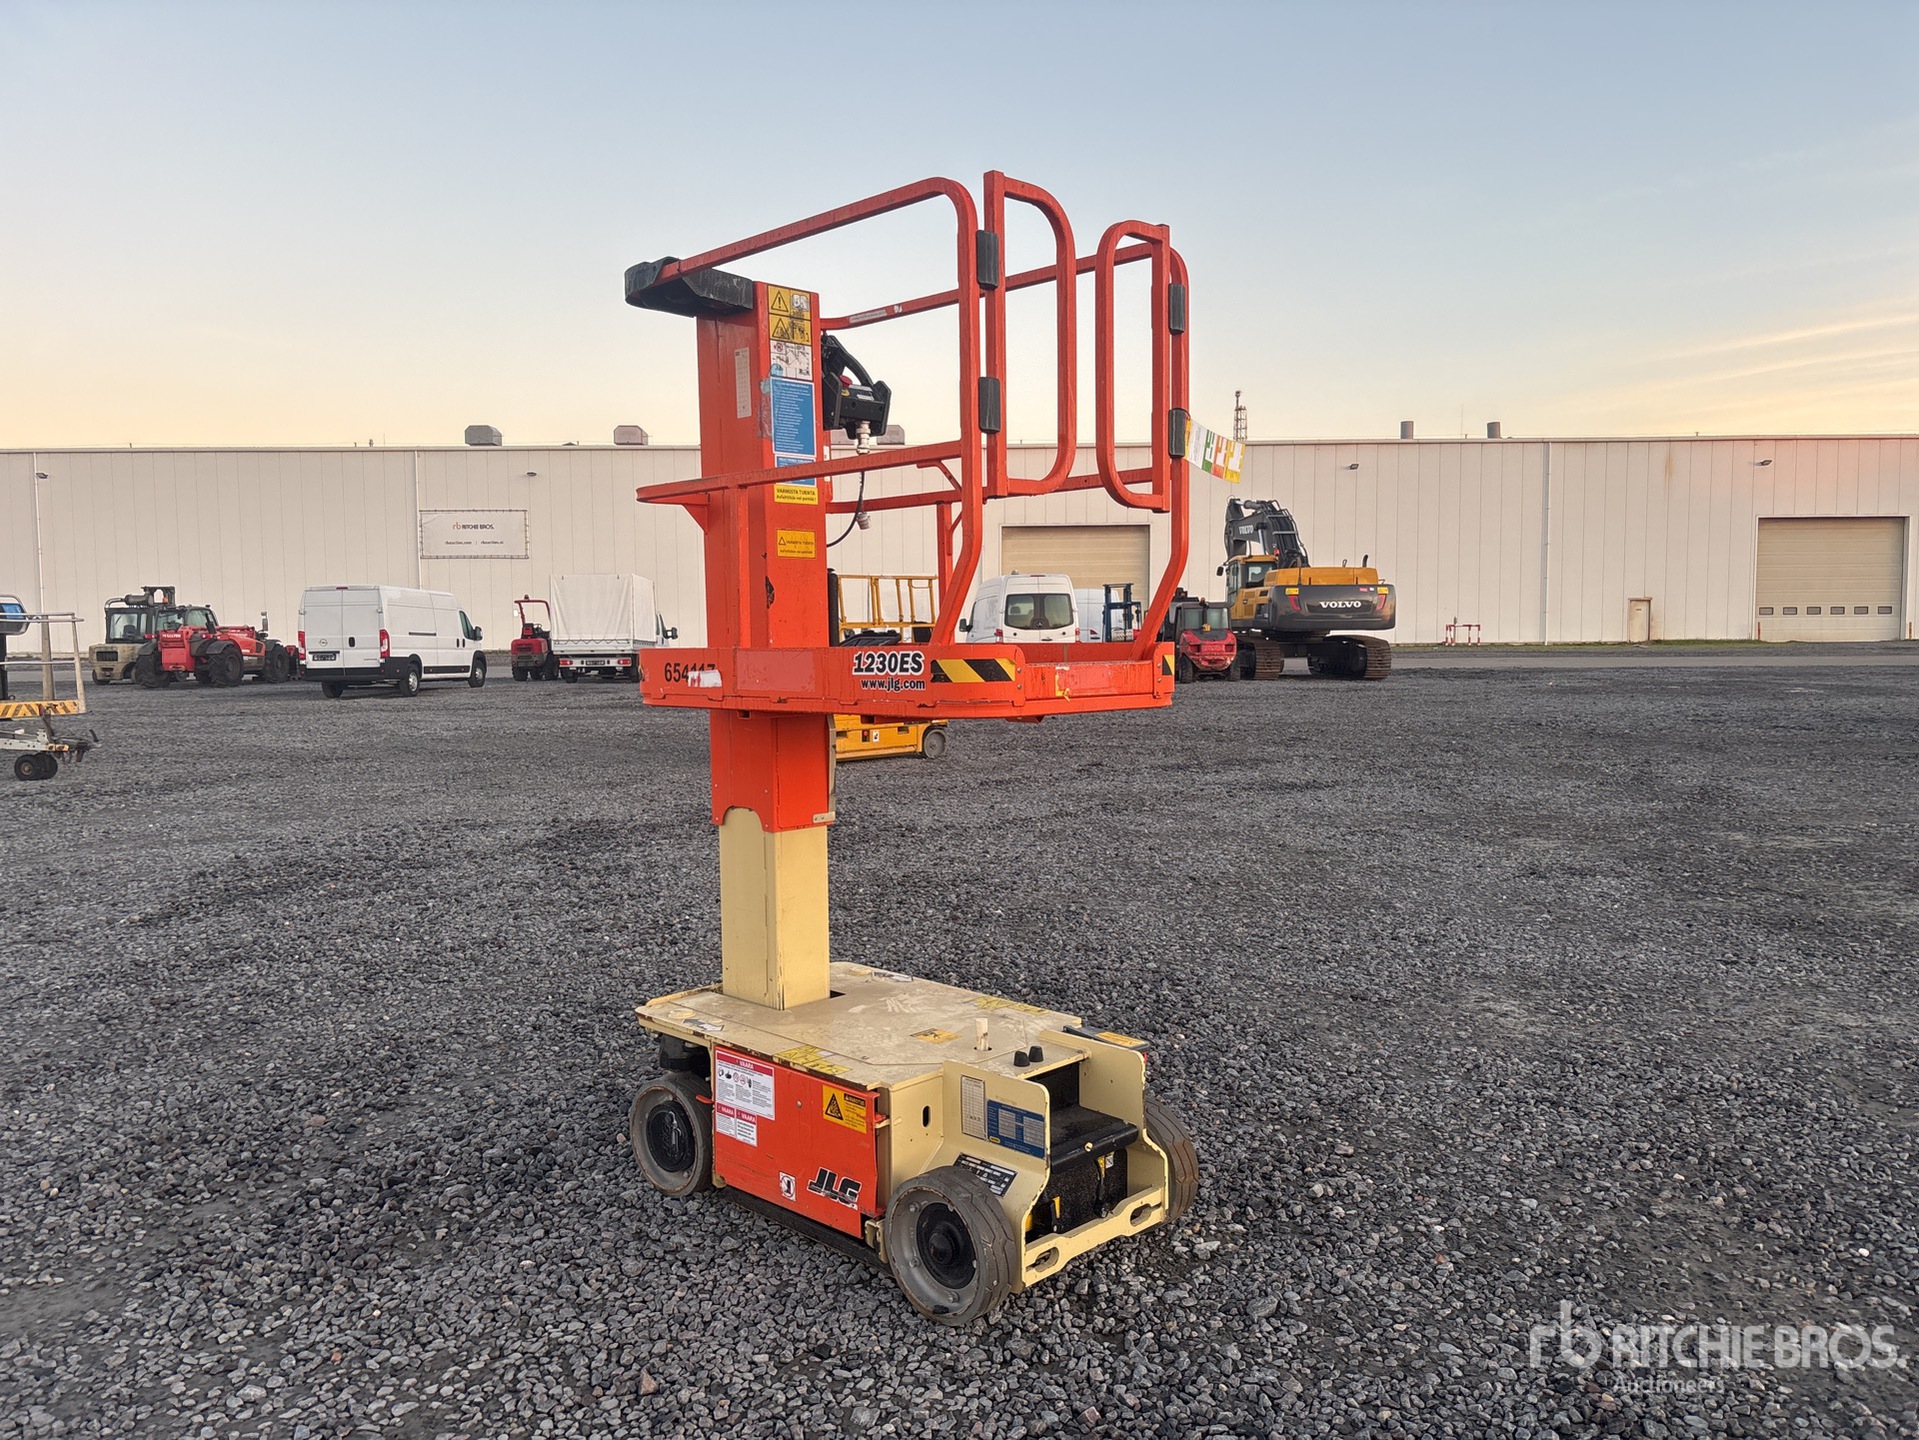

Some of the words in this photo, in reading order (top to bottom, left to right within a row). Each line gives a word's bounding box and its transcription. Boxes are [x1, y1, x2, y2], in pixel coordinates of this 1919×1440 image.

[1239, 525, 1254, 535] VOLVO
[853, 651, 924, 674] 1230ES
[861, 678, 926, 692] www.jlg.com
[807, 1167, 862, 1206] JLG
